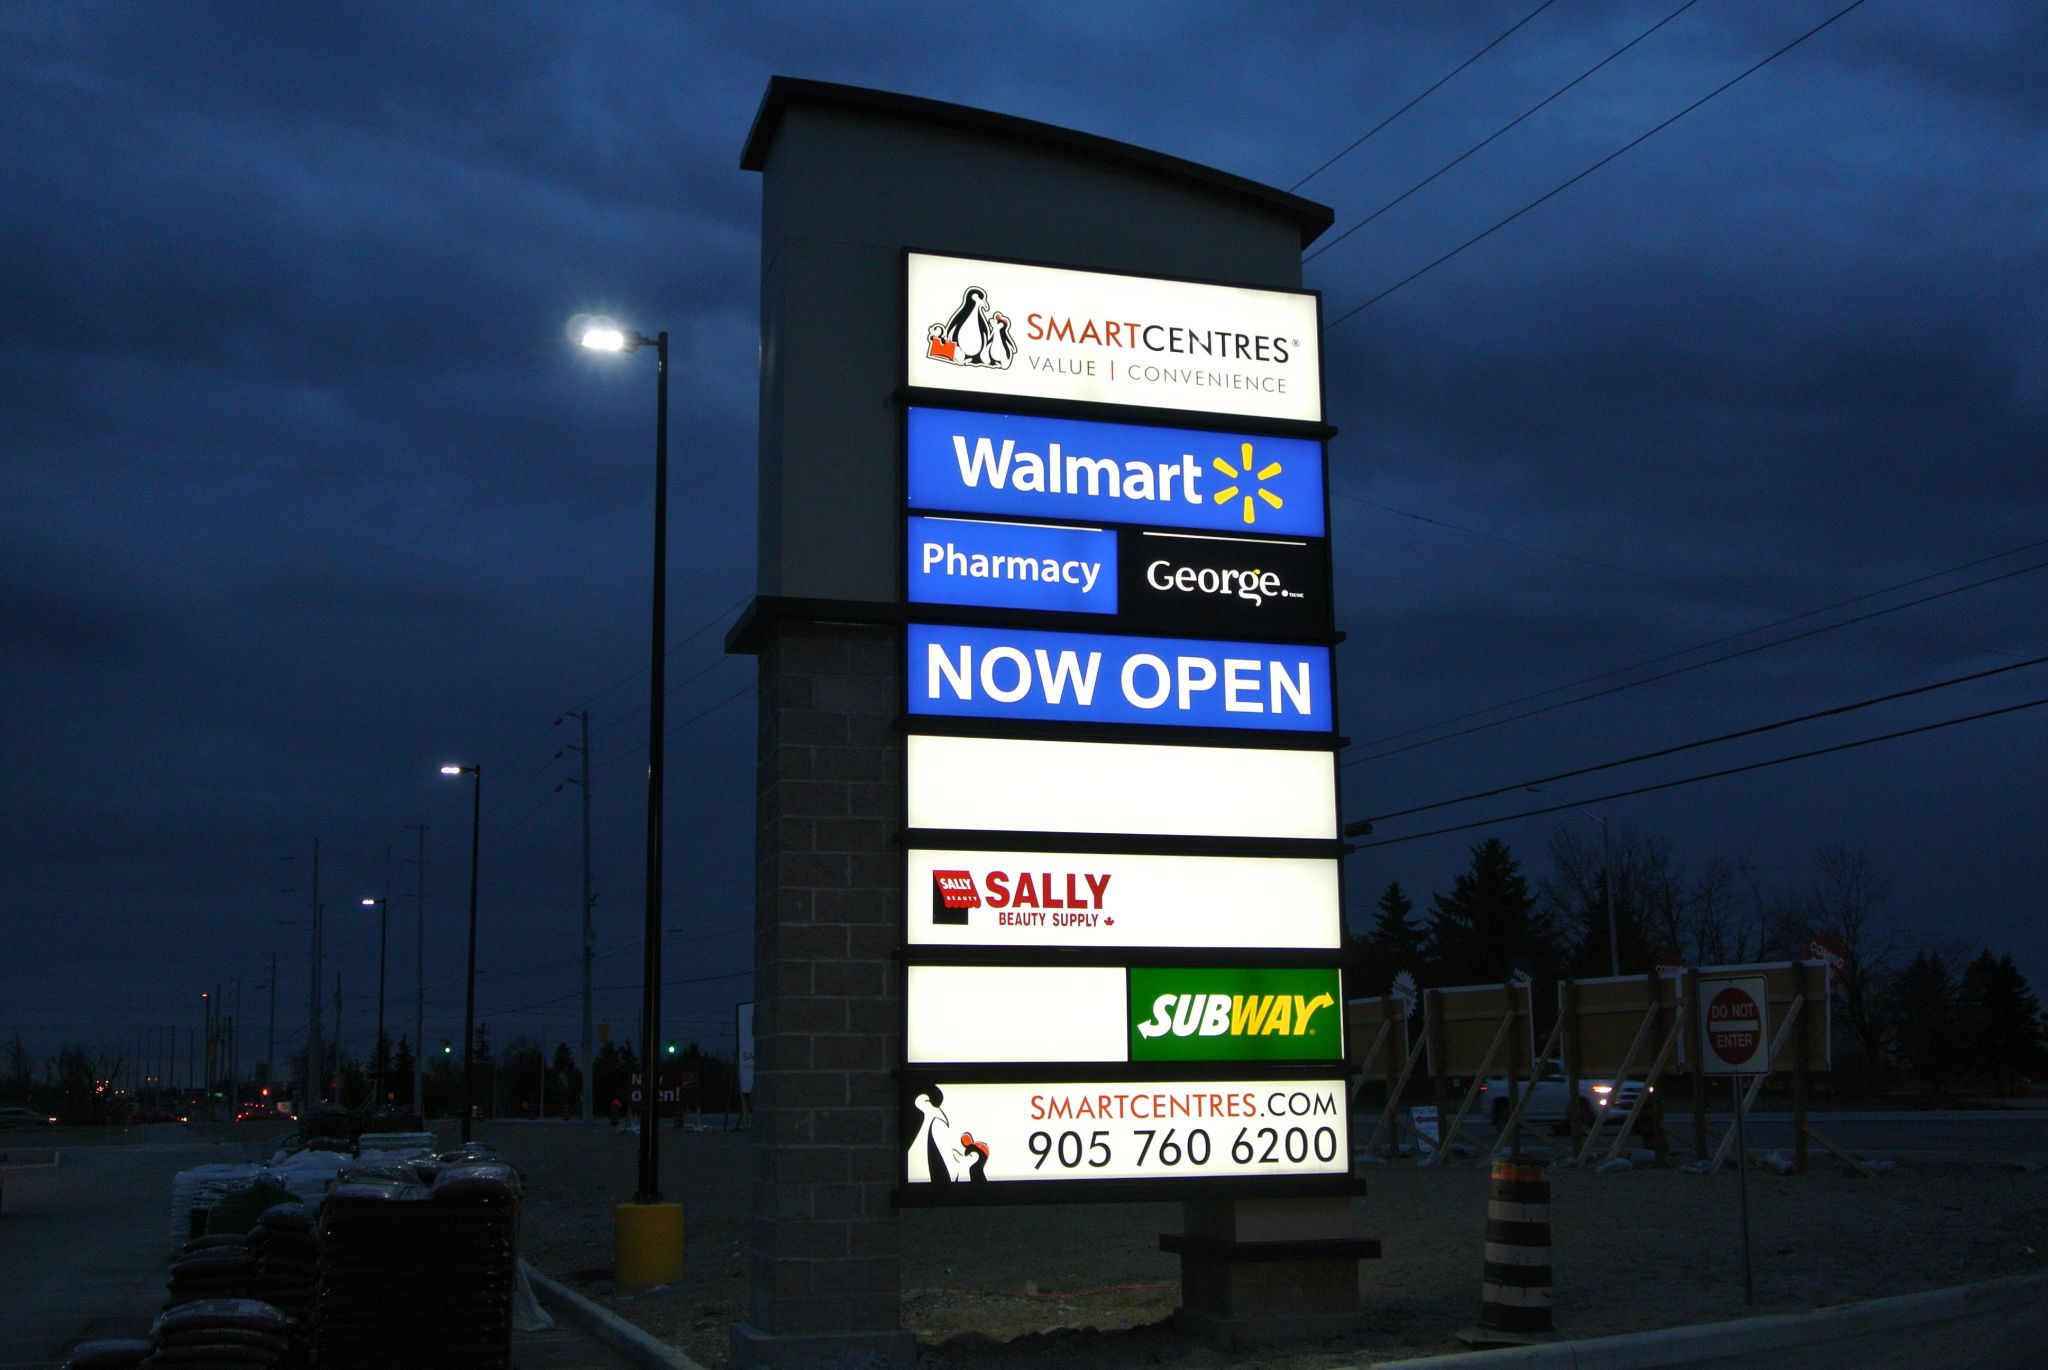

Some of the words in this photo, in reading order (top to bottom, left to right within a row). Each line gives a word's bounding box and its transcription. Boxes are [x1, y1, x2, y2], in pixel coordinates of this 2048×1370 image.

[1028, 355, 1097, 377] VALUE
[1128, 364, 1288, 394] CONVENIENCE
[952, 435, 1203, 504] Walmart
[923, 543, 1101, 593] Pharmacy
[928, 643, 1102, 706] NOW
[1121, 653, 1311, 715] OPEN
[940, 878, 972, 890] SALLY
[985, 871, 1112, 909] SALLY
[999, 912, 1046, 926] BEAUTY
[1053, 913, 1099, 927] SUPPLY
[1137, 992, 1334, 1040] SUBWAY
[1711, 1004, 1728, 1018] DO
[1732, 1003, 1754, 1017] NOT
[1717, 1033, 1753, 1048] ENTER
[631, 1086, 680, 1102] oen!
[1030, 1092, 1338, 1121] SMARTCENTRES.COM
[1028, 1130, 1112, 1170] 905
[1133, 1128, 1211, 1167] 760
[1231, 1126, 1338, 1165] 6200
